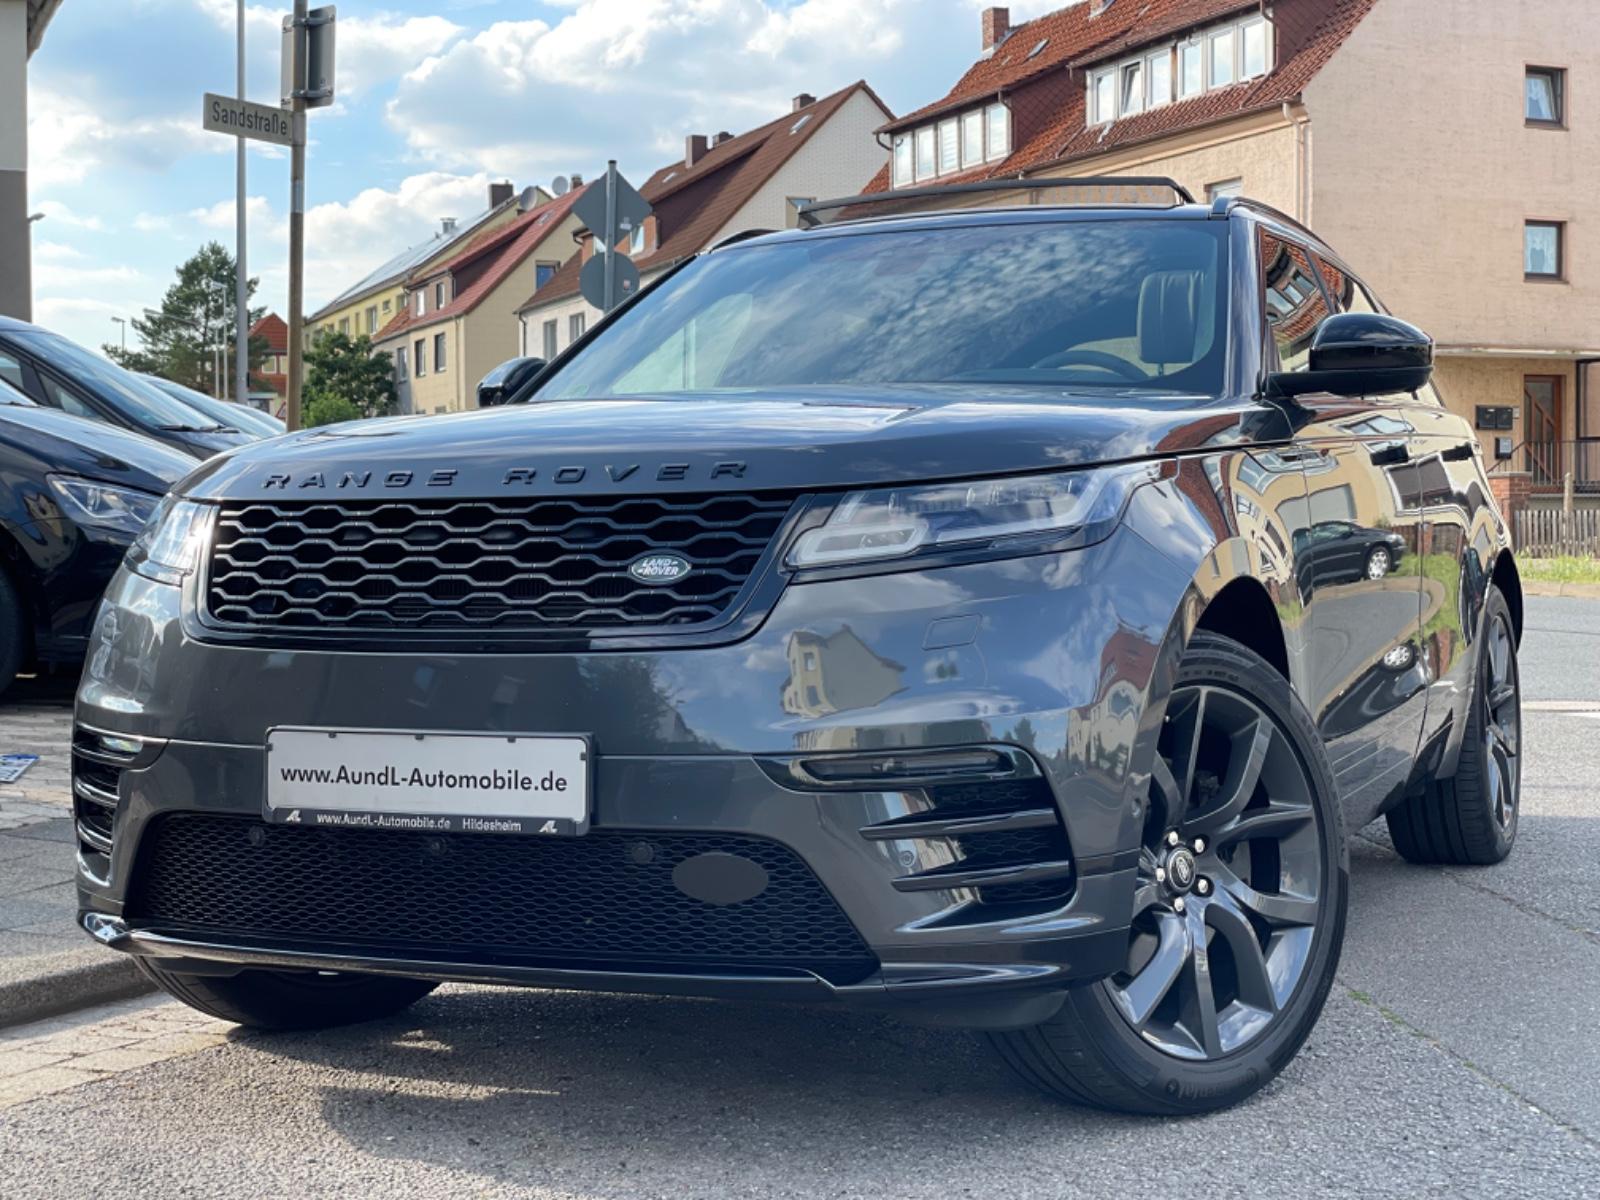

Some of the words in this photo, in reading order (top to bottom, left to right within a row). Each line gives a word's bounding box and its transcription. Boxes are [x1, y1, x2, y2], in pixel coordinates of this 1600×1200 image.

[212, 101, 288, 135] Sandstraße
[261, 468, 458, 489] RANGE
[502, 459, 747, 485] ROVER
[280, 764, 568, 792] www.AundL-Automobile.de
[316, 813, 451, 829] www.AundL-Automobile.de
[462, 818, 522, 831] Hildesheim
